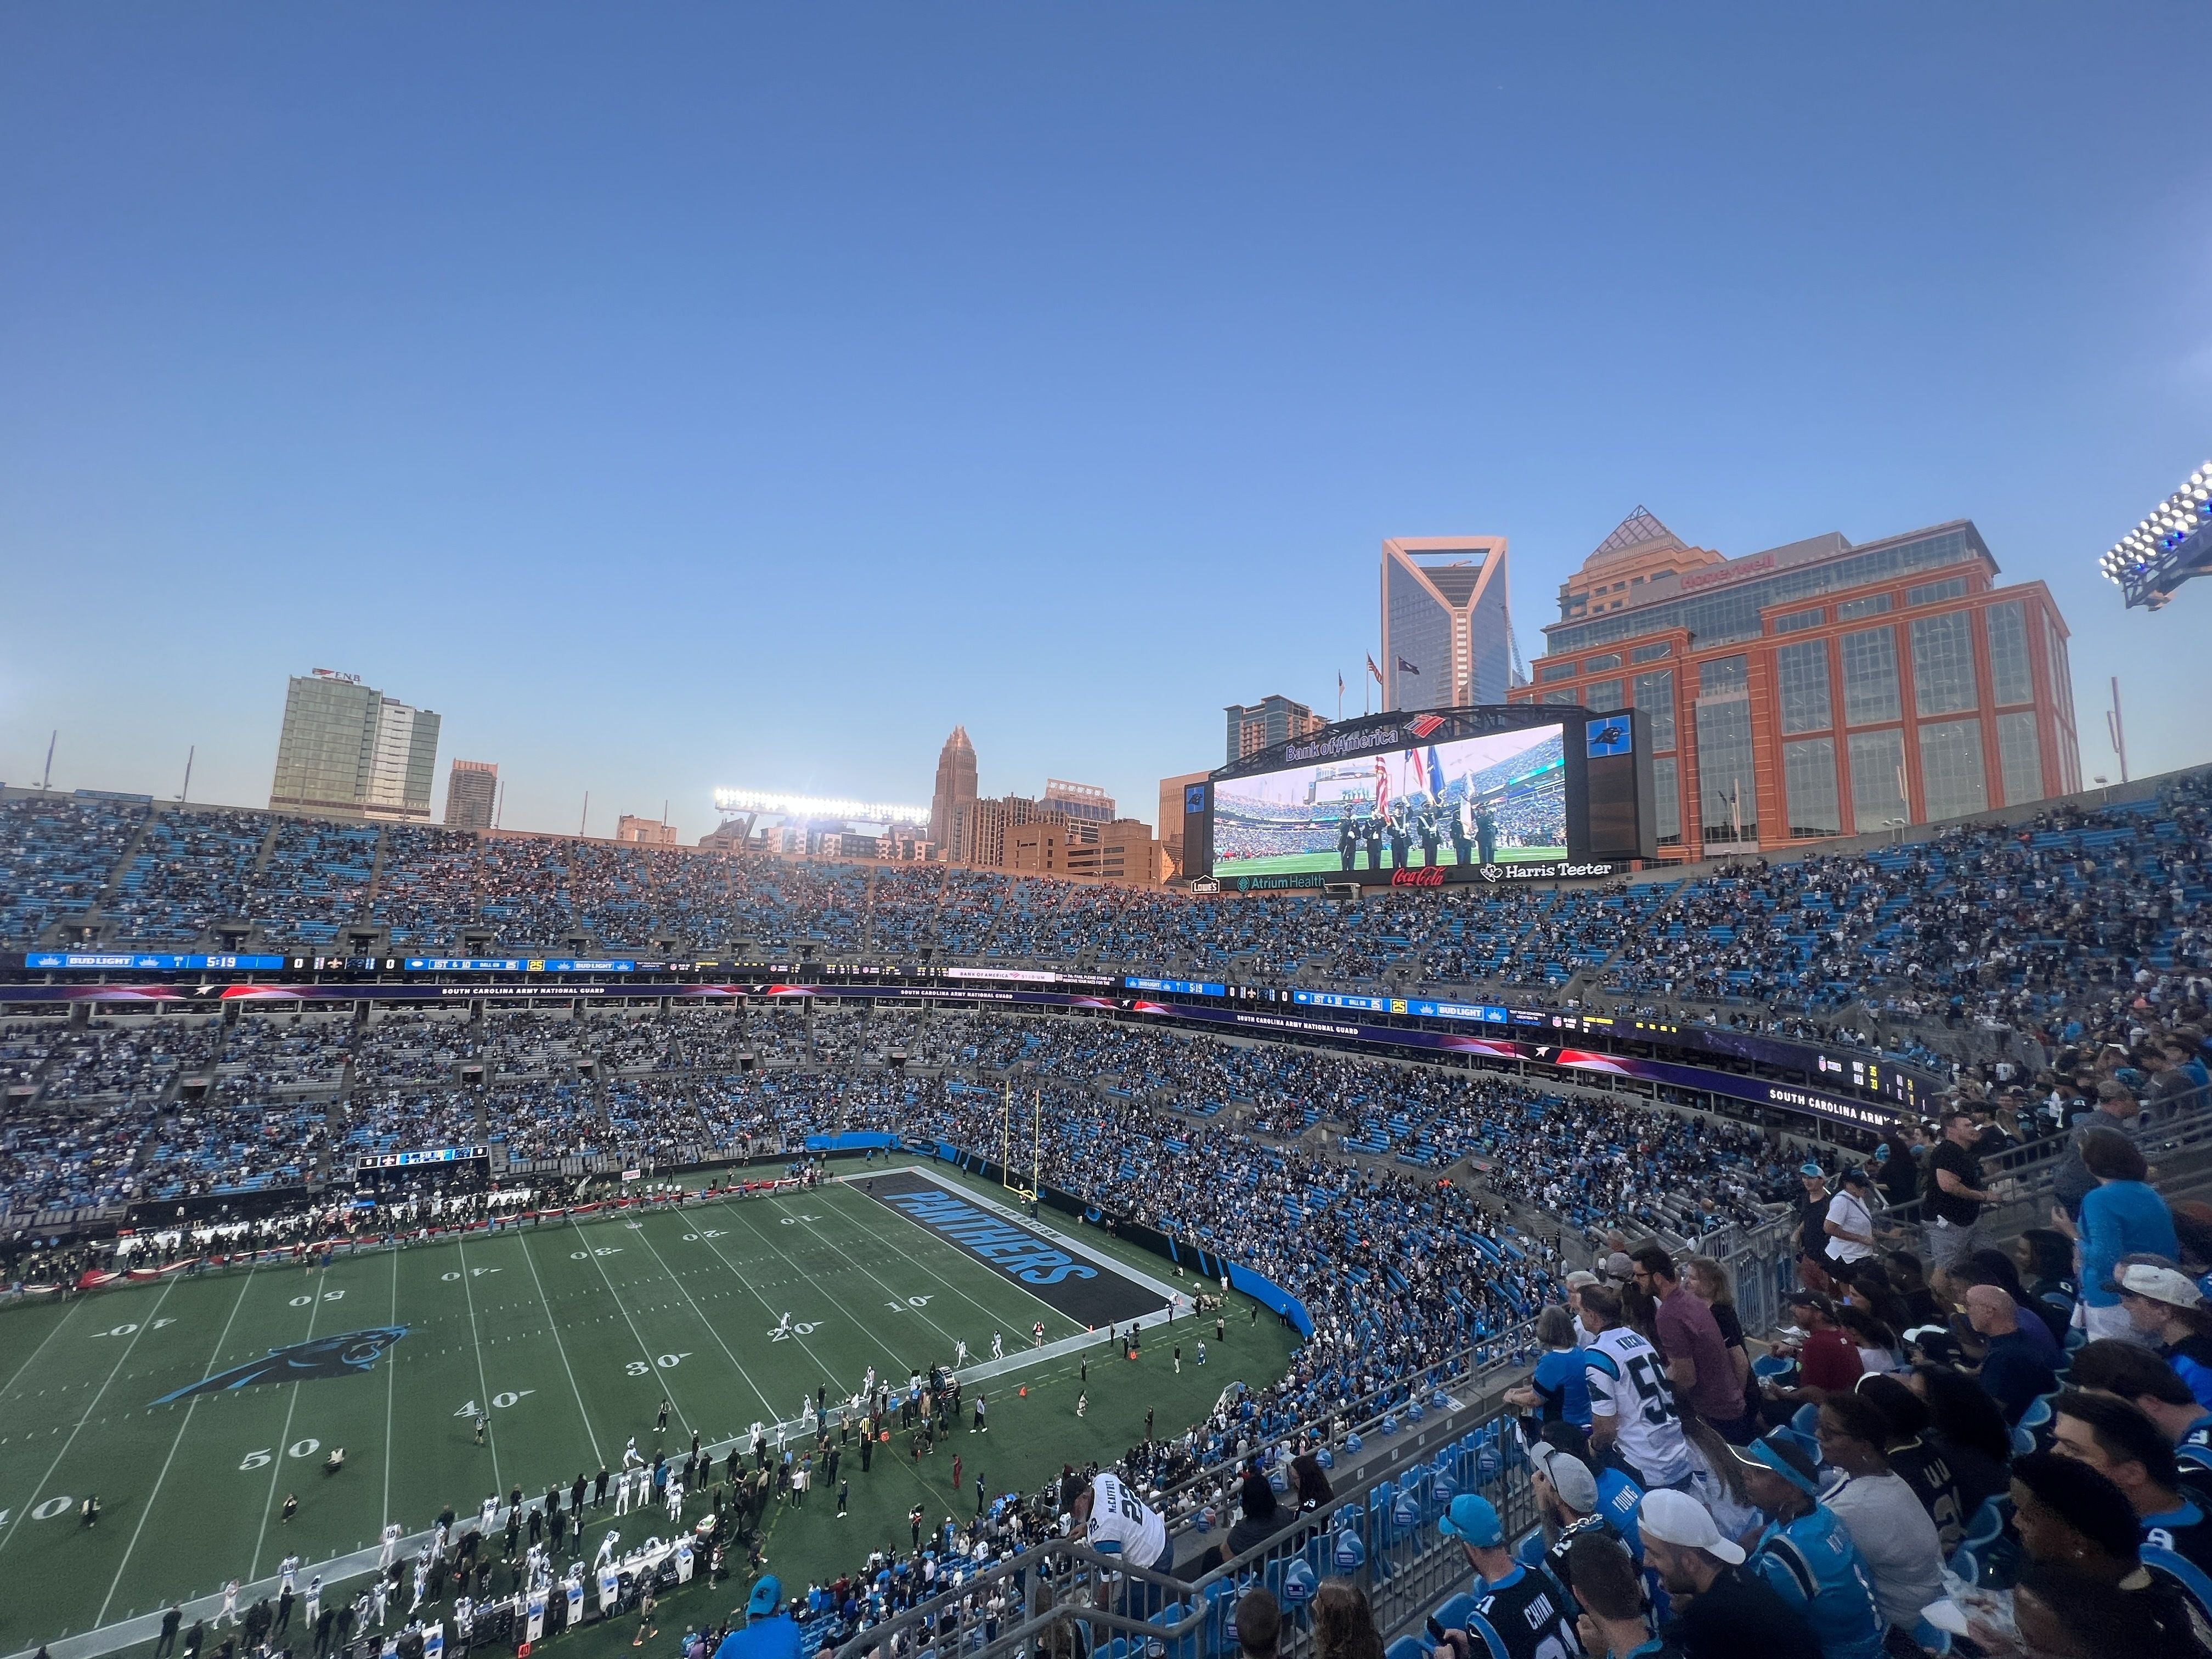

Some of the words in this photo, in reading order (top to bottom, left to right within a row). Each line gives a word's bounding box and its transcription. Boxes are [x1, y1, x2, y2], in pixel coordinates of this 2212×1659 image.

[1681, 554, 1774, 589] Honeywell
[1285, 741, 1320, 761] Bank
[1320, 736, 1336, 755] of
[1336, 730, 1398, 753] America
[1505, 865, 1555, 878] Harris
[1557, 862, 1611, 876] Teeter
[1193, 882, 1217, 892] LOWE'S
[1251, 877, 1288, 889] Atrium
[1290, 874, 1325, 888] Health
[206, 957, 236, 967] 5:19
[294, 958, 303, 968] 0
[386, 959, 395, 969] 0
[529, 961, 543, 970] 25
[1189, 983, 1203, 993] 5:19
[1229, 987, 1235, 997] 0
[1282, 991, 1288, 1001] 0
[1392, 1001, 1405, 1012] 25
[1439, 1006, 1457, 1015] BUD
[1458, 1007, 1481, 1017] LIGHT
[1256, 1017, 1284, 1026] CAROLINA
[1304, 1023, 1334, 1032] NATIONAL
[1336, 1026, 1358, 1035] GUARD
[1770, 1089, 1805, 1105] SOUTH
[1809, 1097, 1857, 1119] CAROLINA
[991, 1206, 1016, 1216] END
[1017, 1217, 1062, 1239] RACISM
[883, 1190, 1098, 1284] PANTHERS
[1119, 1483, 1143, 1527] 22
[1611, 1485, 1638, 1514] YOUNG
[387, 1530, 396, 1539] 10
[1523, 1592, 1555, 1630] CHINN
[520, 1645, 529, 1656] 40
